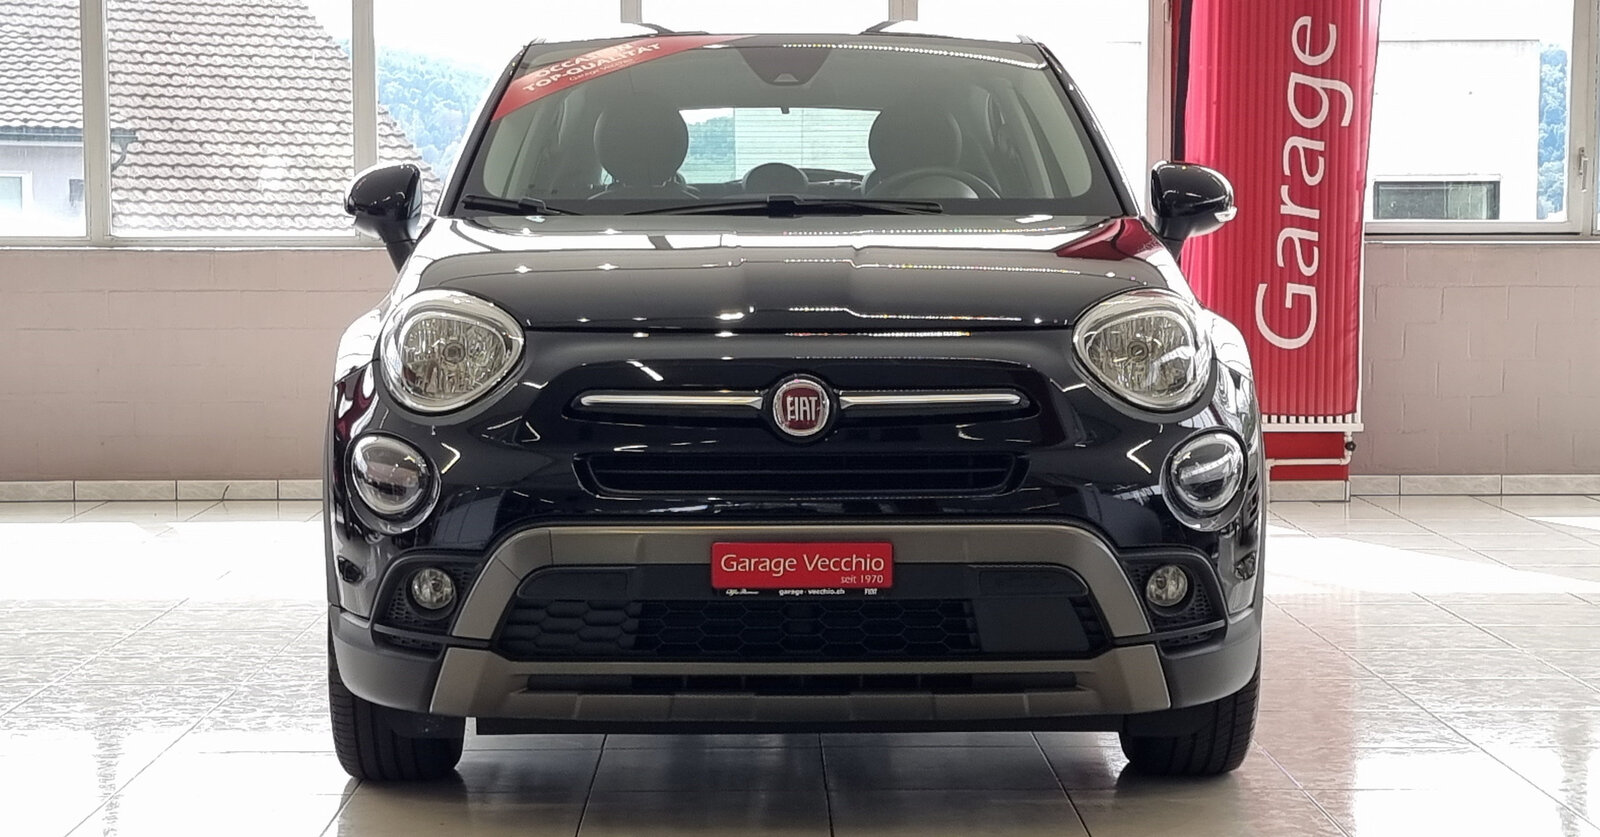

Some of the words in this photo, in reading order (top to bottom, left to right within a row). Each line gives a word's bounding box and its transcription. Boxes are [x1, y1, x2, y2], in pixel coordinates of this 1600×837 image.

[1255, 15, 1354, 350] Garage
[786, 396, 818, 421] FIAT
[721, 554, 797, 577] Garage
[803, 554, 885, 572] Vecchio
[841, 575, 857, 584] seit
[860, 574, 884, 584] 1970
